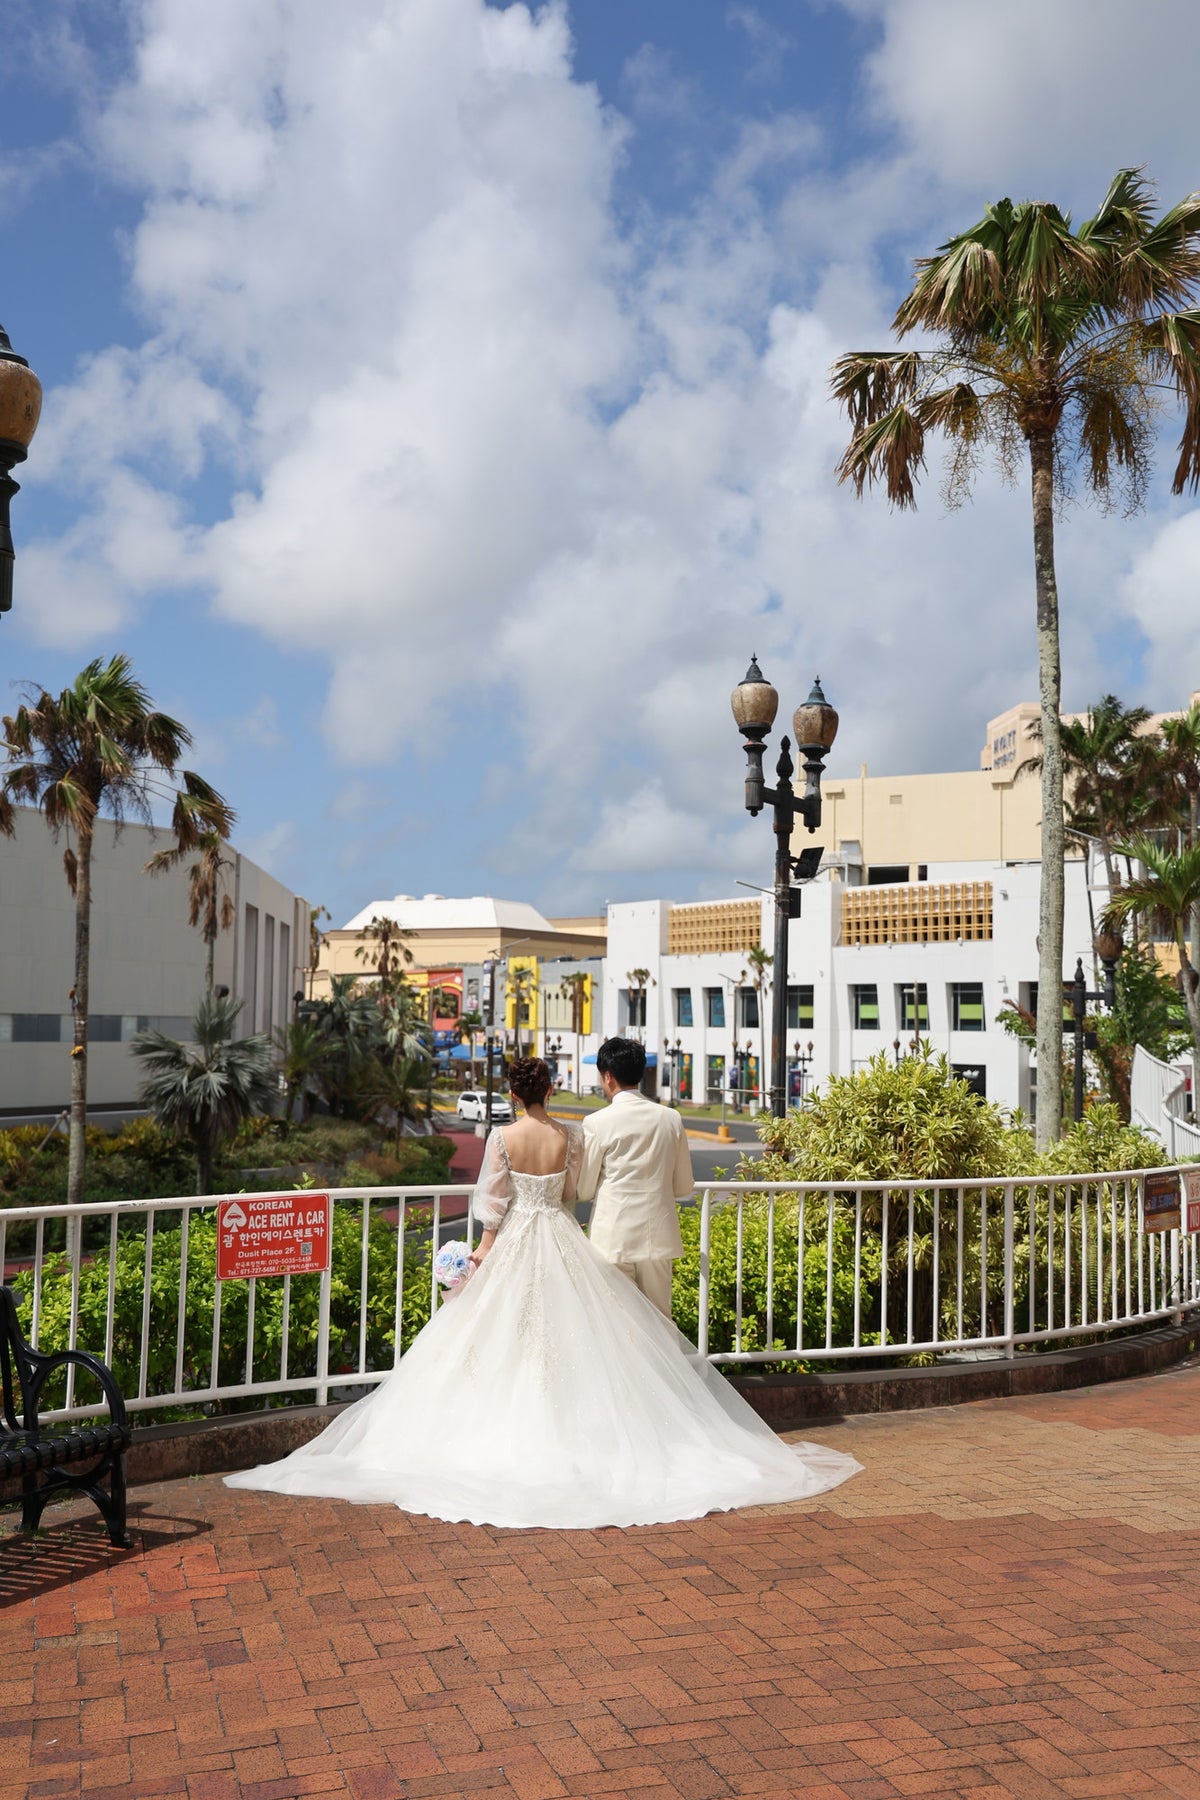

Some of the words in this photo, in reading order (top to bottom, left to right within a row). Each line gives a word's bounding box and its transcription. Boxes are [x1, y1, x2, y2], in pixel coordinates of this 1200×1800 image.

[249, 1200, 293, 1211] KOREAN
[248, 1214, 267, 1229] ACE
[270, 1212, 295, 1228] RENT
[297, 1211, 304, 1225] A
[306, 1210, 325, 1224] CAR
[239, 1227, 325, 1247] 한인에이스렌트카
[238, 1249, 259, 1258] Dusit
[261, 1248, 283, 1257] Place
